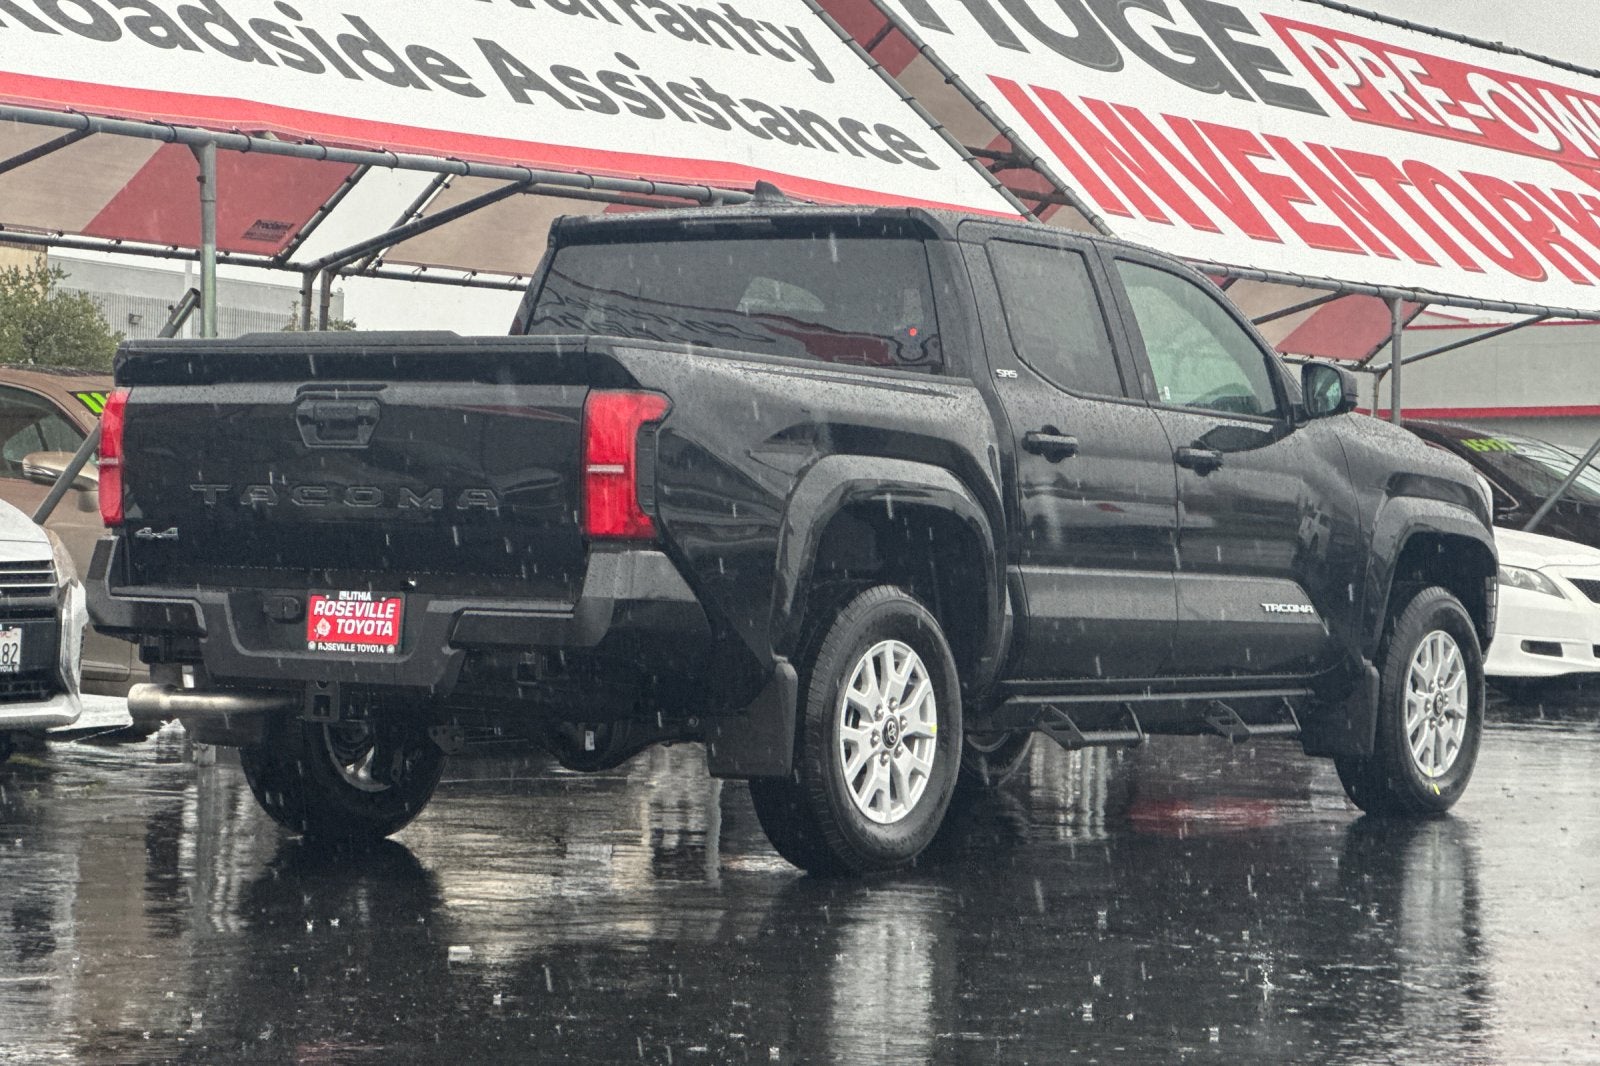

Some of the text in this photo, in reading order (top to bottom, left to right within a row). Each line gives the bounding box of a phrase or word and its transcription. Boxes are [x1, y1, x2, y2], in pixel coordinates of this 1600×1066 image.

[472, 0, 835, 84] ranty
[472, 37, 941, 170] Assistance
[1285, 27, 1600, 160] PRE-OW
[190, 484, 500, 512] TACOMA
[346, 590, 372, 601] LITHIA
[313, 600, 396, 618] ROSEVILLE
[1260, 602, 1315, 614] TACOMA
[336, 618, 393, 636] TOYOTA
[2, 642, 18, 665] 82
[317, 642, 384, 654] ROSEVILLE TOYOTA
